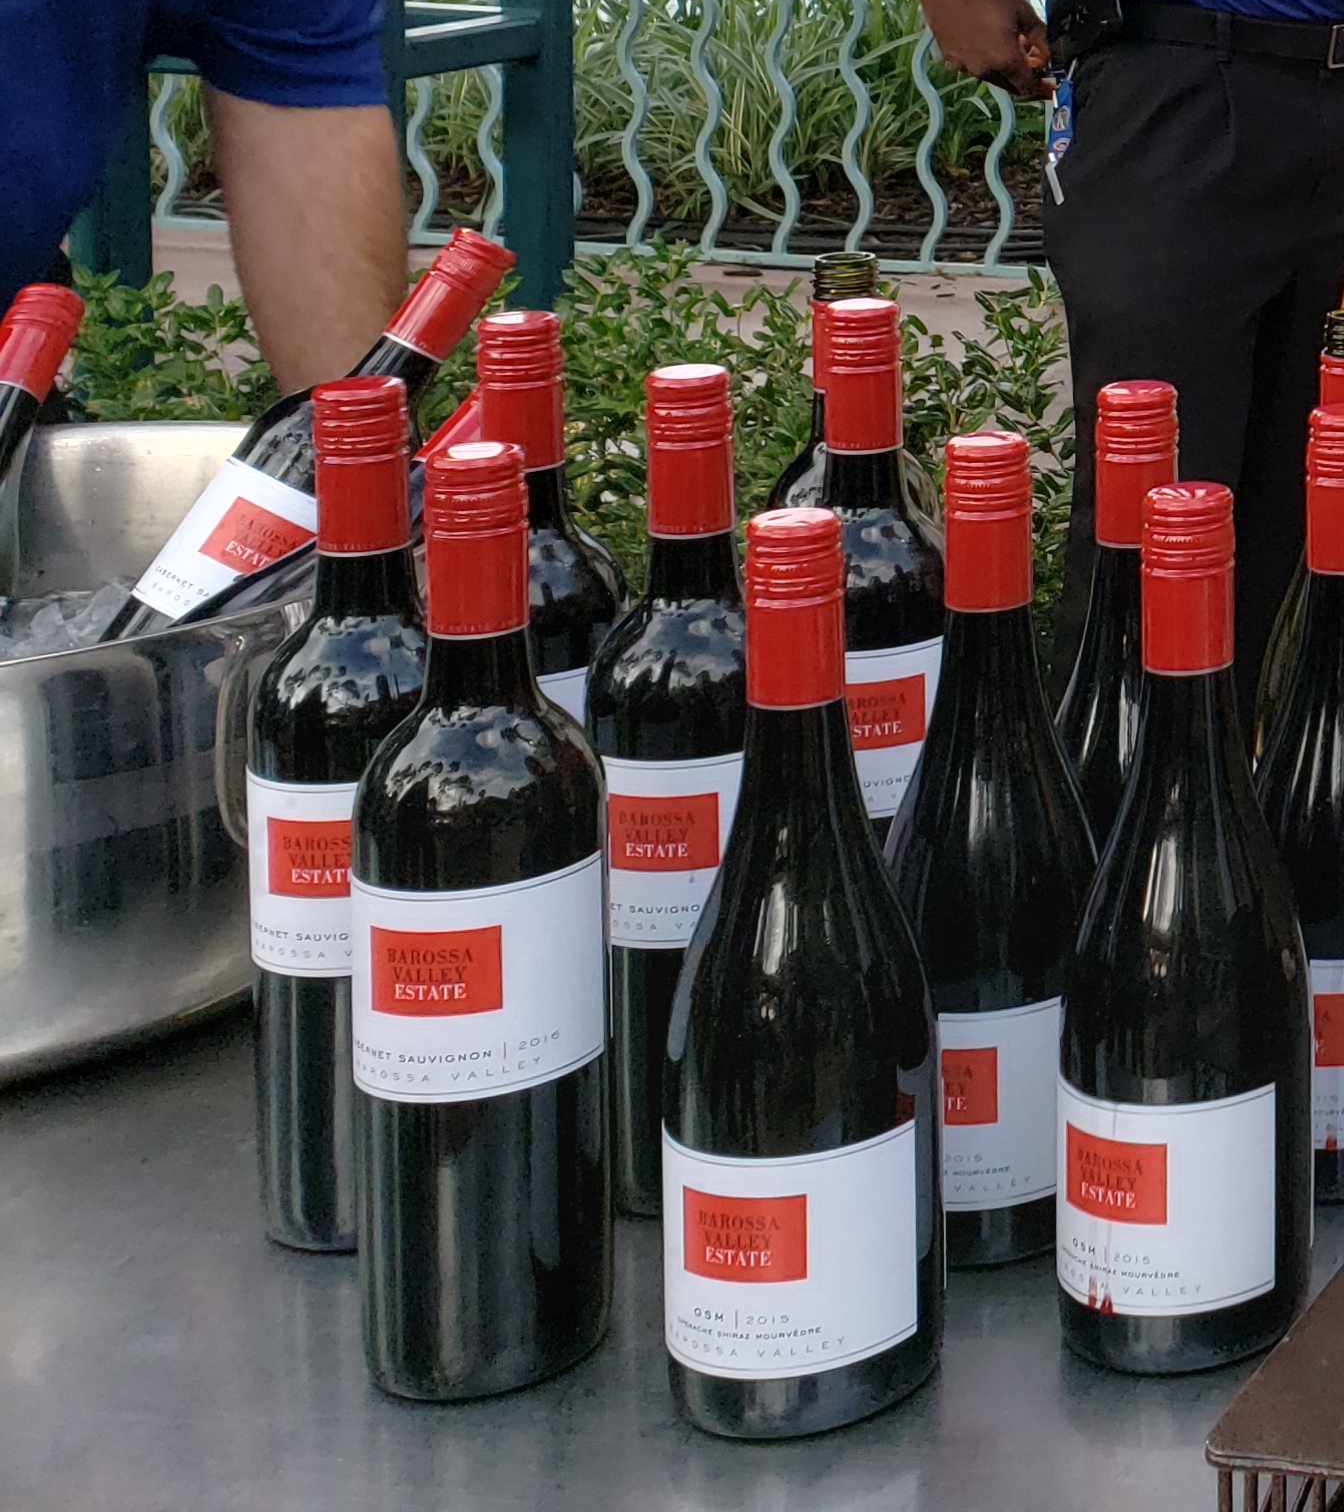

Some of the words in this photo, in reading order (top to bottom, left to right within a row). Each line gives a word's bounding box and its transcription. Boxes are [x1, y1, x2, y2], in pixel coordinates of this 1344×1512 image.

[225, 540, 272, 568] ESTAT
[155, 565, 194, 590] CABERNET
[151, 581, 191, 607] BAROS
[847, 692, 906, 709] AROSSA
[852, 708, 900, 724] ALLEY
[853, 721, 902, 738] STATE
[619, 811, 695, 826] BAROSSA
[283, 836, 351, 851] BAROSS
[624, 828, 688, 842] VALLEY
[626, 842, 688, 858] ESTATE
[289, 853, 351, 868] VALLE
[630, 904, 700, 914] SAUVIGNO
[296, 933, 349, 941] SAUVIG
[387, 948, 473, 964] BAROSSA
[393, 966, 468, 983] VALLEY
[394, 983, 467, 1001] ESTATE
[398, 1049, 492, 1064] SAUVIGNON
[519, 1030, 560, 1051] 2016
[450, 1057, 542, 1081] VALLEY
[1078, 1147, 1142, 1175] BAROSSA
[954, 1176, 1031, 1192] VALLEY
[1080, 1165, 1137, 1191] VALLEY
[1081, 1182, 1136, 1209] ESTATE
[699, 1211, 780, 1231] BAROSSA
[704, 1230, 773, 1250] VALLEY
[706, 1246, 772, 1266] ESTATE
[1123, 1284, 1203, 1296] VALLEY
[694, 1308, 724, 1322] GSM
[746, 1315, 790, 1325] 2015
[718, 1331, 750, 1340] SHIRAZ
[757, 1336, 845, 1358] VALLEY
